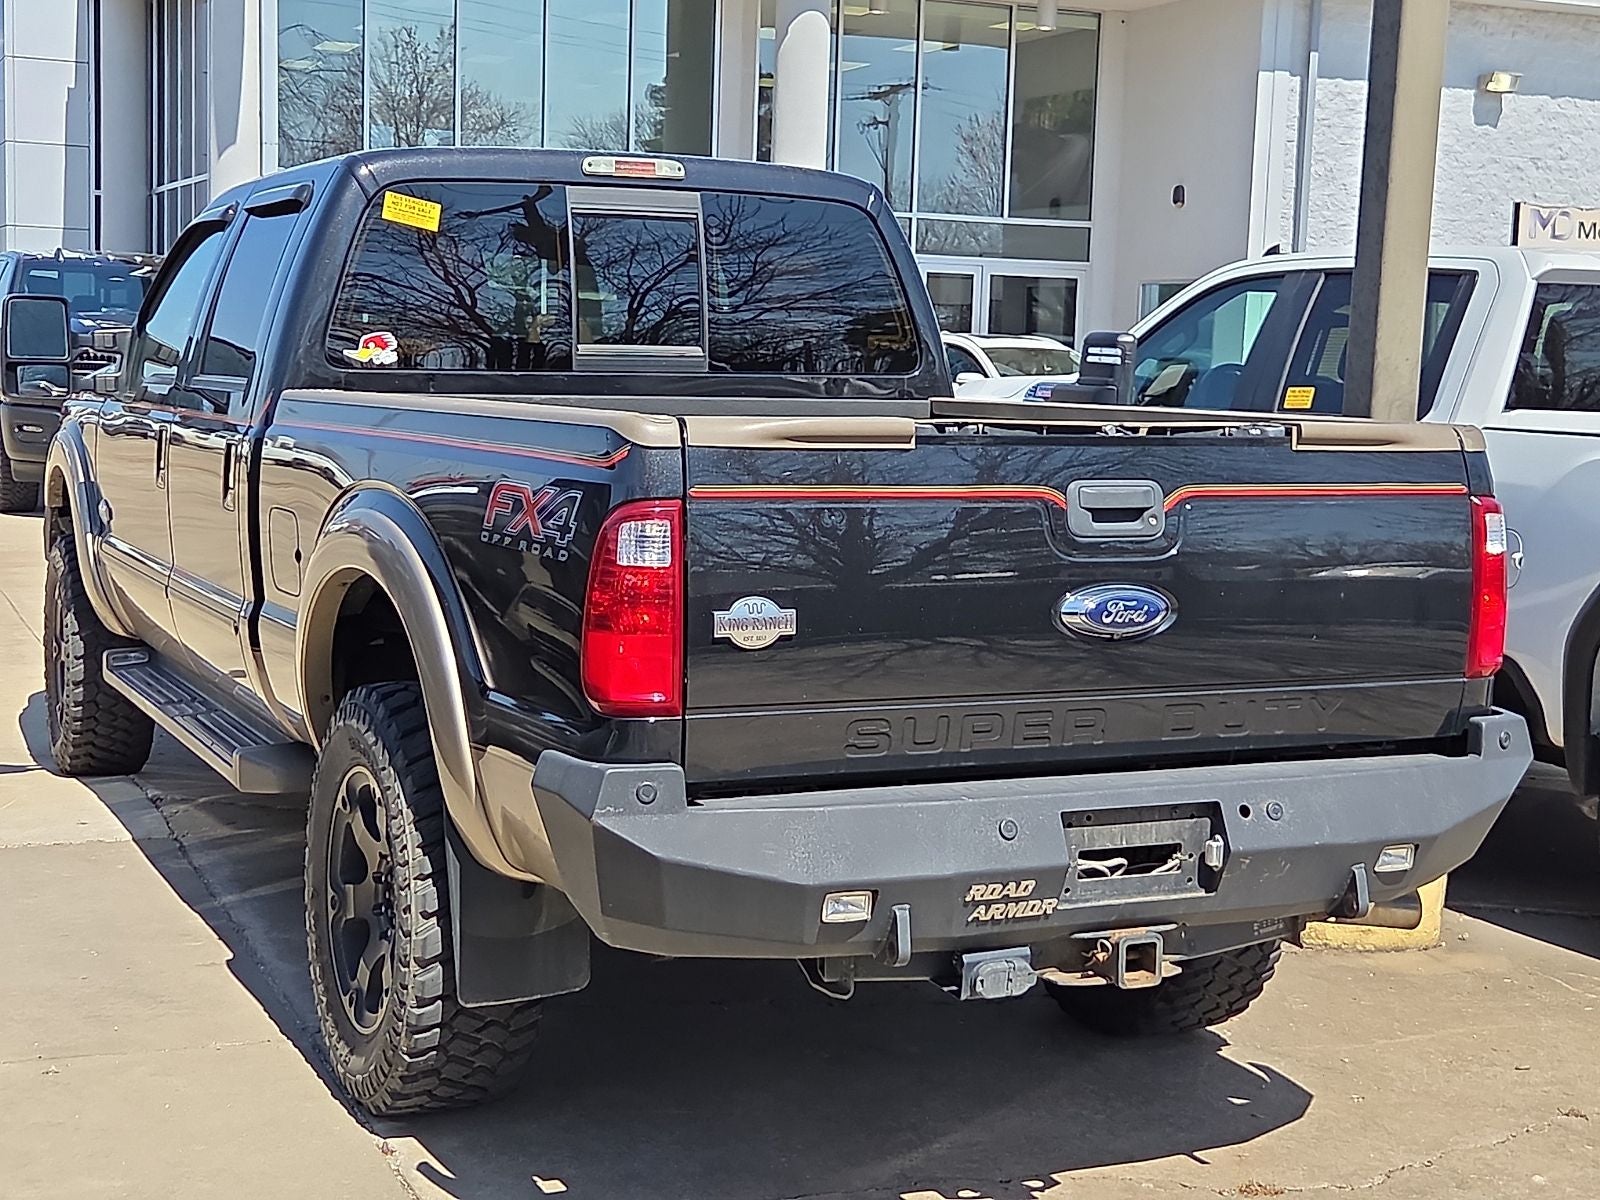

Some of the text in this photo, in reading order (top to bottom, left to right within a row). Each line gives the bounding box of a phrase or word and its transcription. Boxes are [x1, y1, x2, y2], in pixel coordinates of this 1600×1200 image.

[1577, 220, 1600, 241] M
[482, 478, 584, 547] FX4
[480, 530, 569, 562] OFF ROAD
[718, 613, 793, 632] KING RANCH
[1101, 599, 1149, 624] Ford
[844, 695, 1344, 758] SUPER DUTY
[964, 879, 1037, 902] ROAD
[967, 897, 1059, 922] ARMOR
